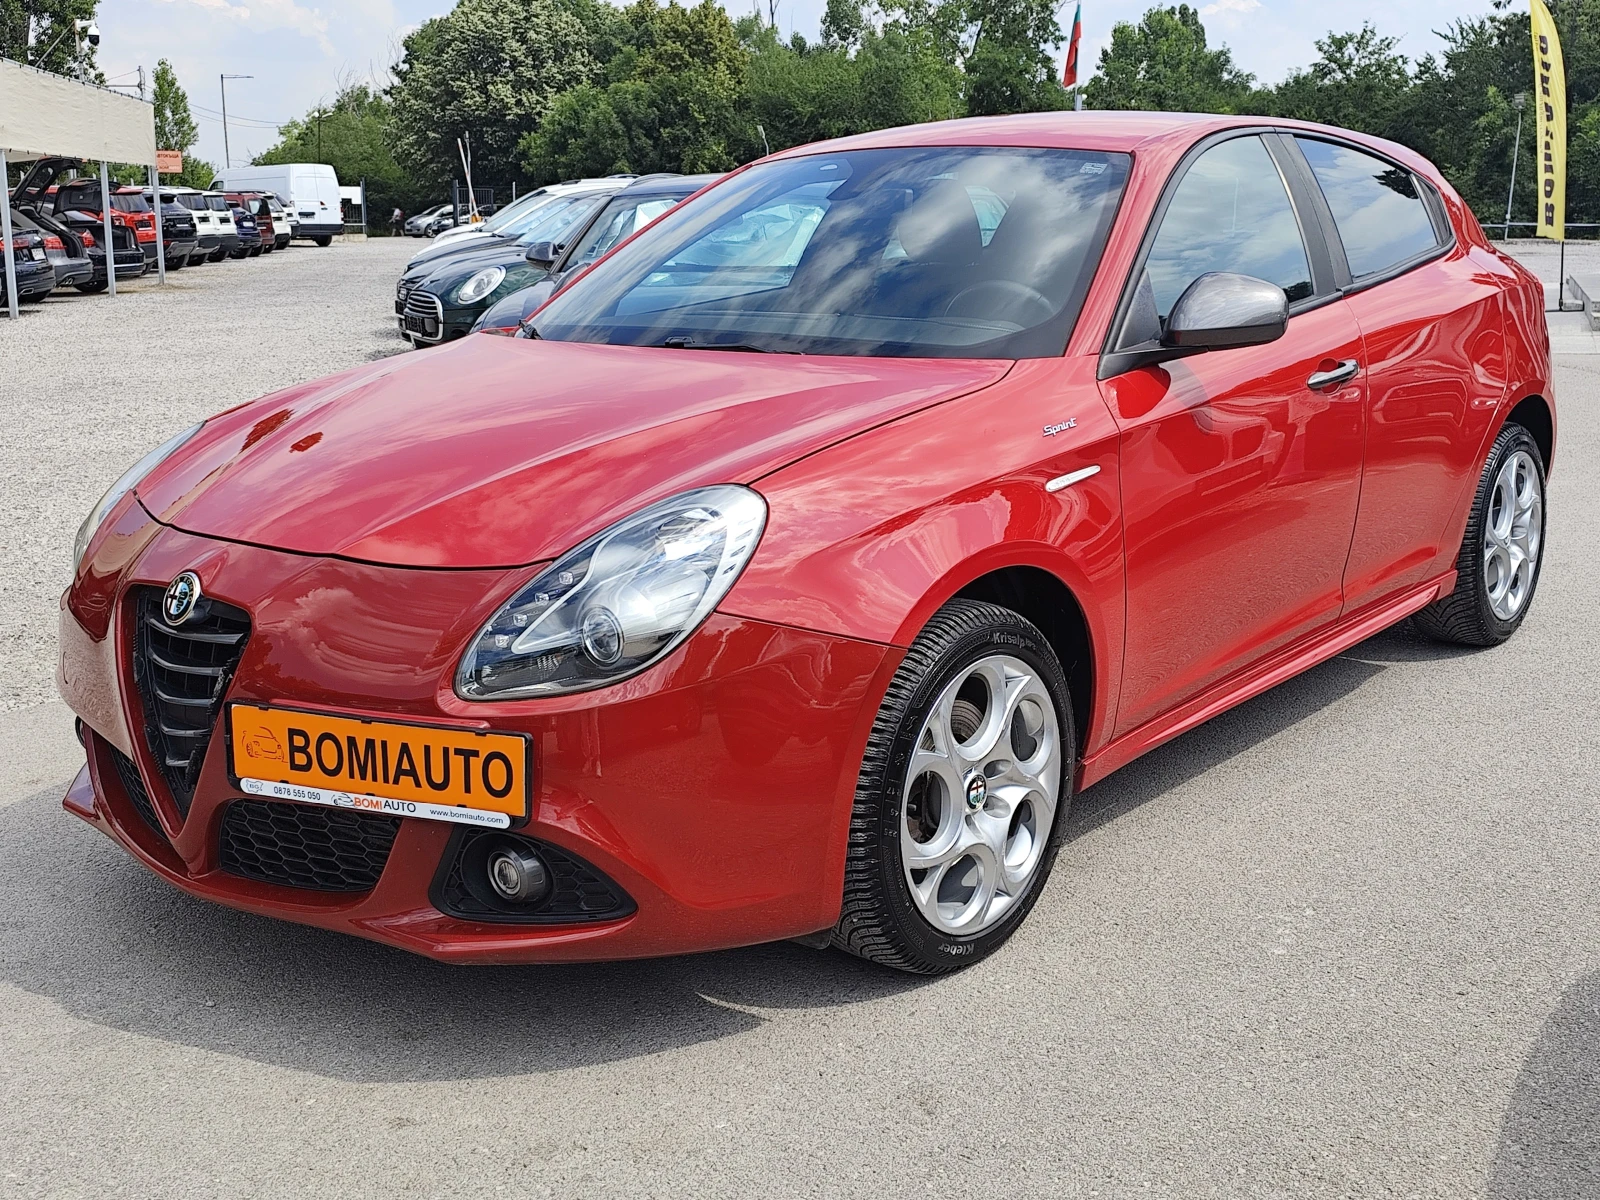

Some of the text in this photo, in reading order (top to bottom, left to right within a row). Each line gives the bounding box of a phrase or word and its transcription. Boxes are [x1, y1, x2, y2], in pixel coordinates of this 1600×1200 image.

[1042, 417, 1078, 437] Sprint
[993, 631, 1025, 649] Krisalp
[287, 727, 514, 799] BOMIAUTO
[273, 786, 321, 801] 0878 555 050
[429, 808, 504, 824] www.bomiauto.com
[938, 943, 975, 956] Kleber
